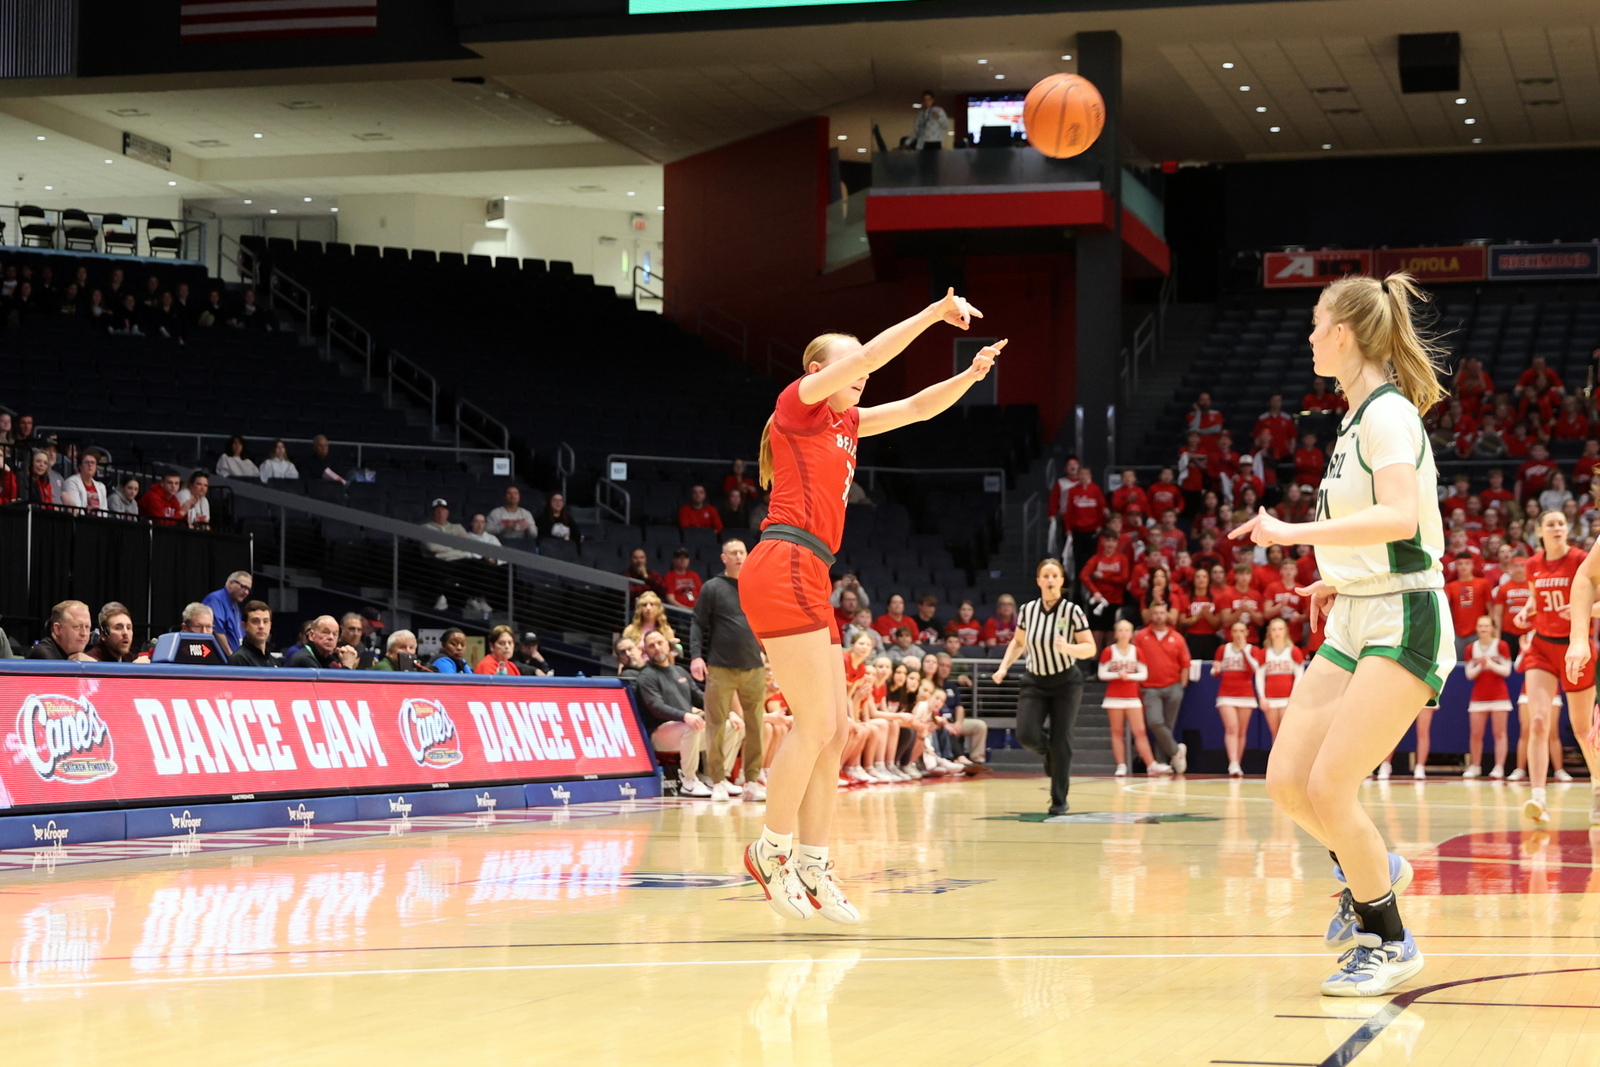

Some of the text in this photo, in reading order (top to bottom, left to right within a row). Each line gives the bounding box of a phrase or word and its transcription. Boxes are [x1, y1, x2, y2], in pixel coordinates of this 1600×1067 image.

[1402, 256, 1460, 272] LOYOLA
[1498, 253, 1591, 270] RICHMOND
[1535, 577, 1570, 588] BELLEVUE
[1540, 590, 1565, 612] 30
[189, 644, 203, 657] POSS
[133, 698, 389, 776] DANCE CAM
[467, 701, 637, 763] DANCE CAM
[180, 810, 202, 836] Kroger
[298, 803, 315, 827] Kroger
[43, 820, 70, 848] Kroger
